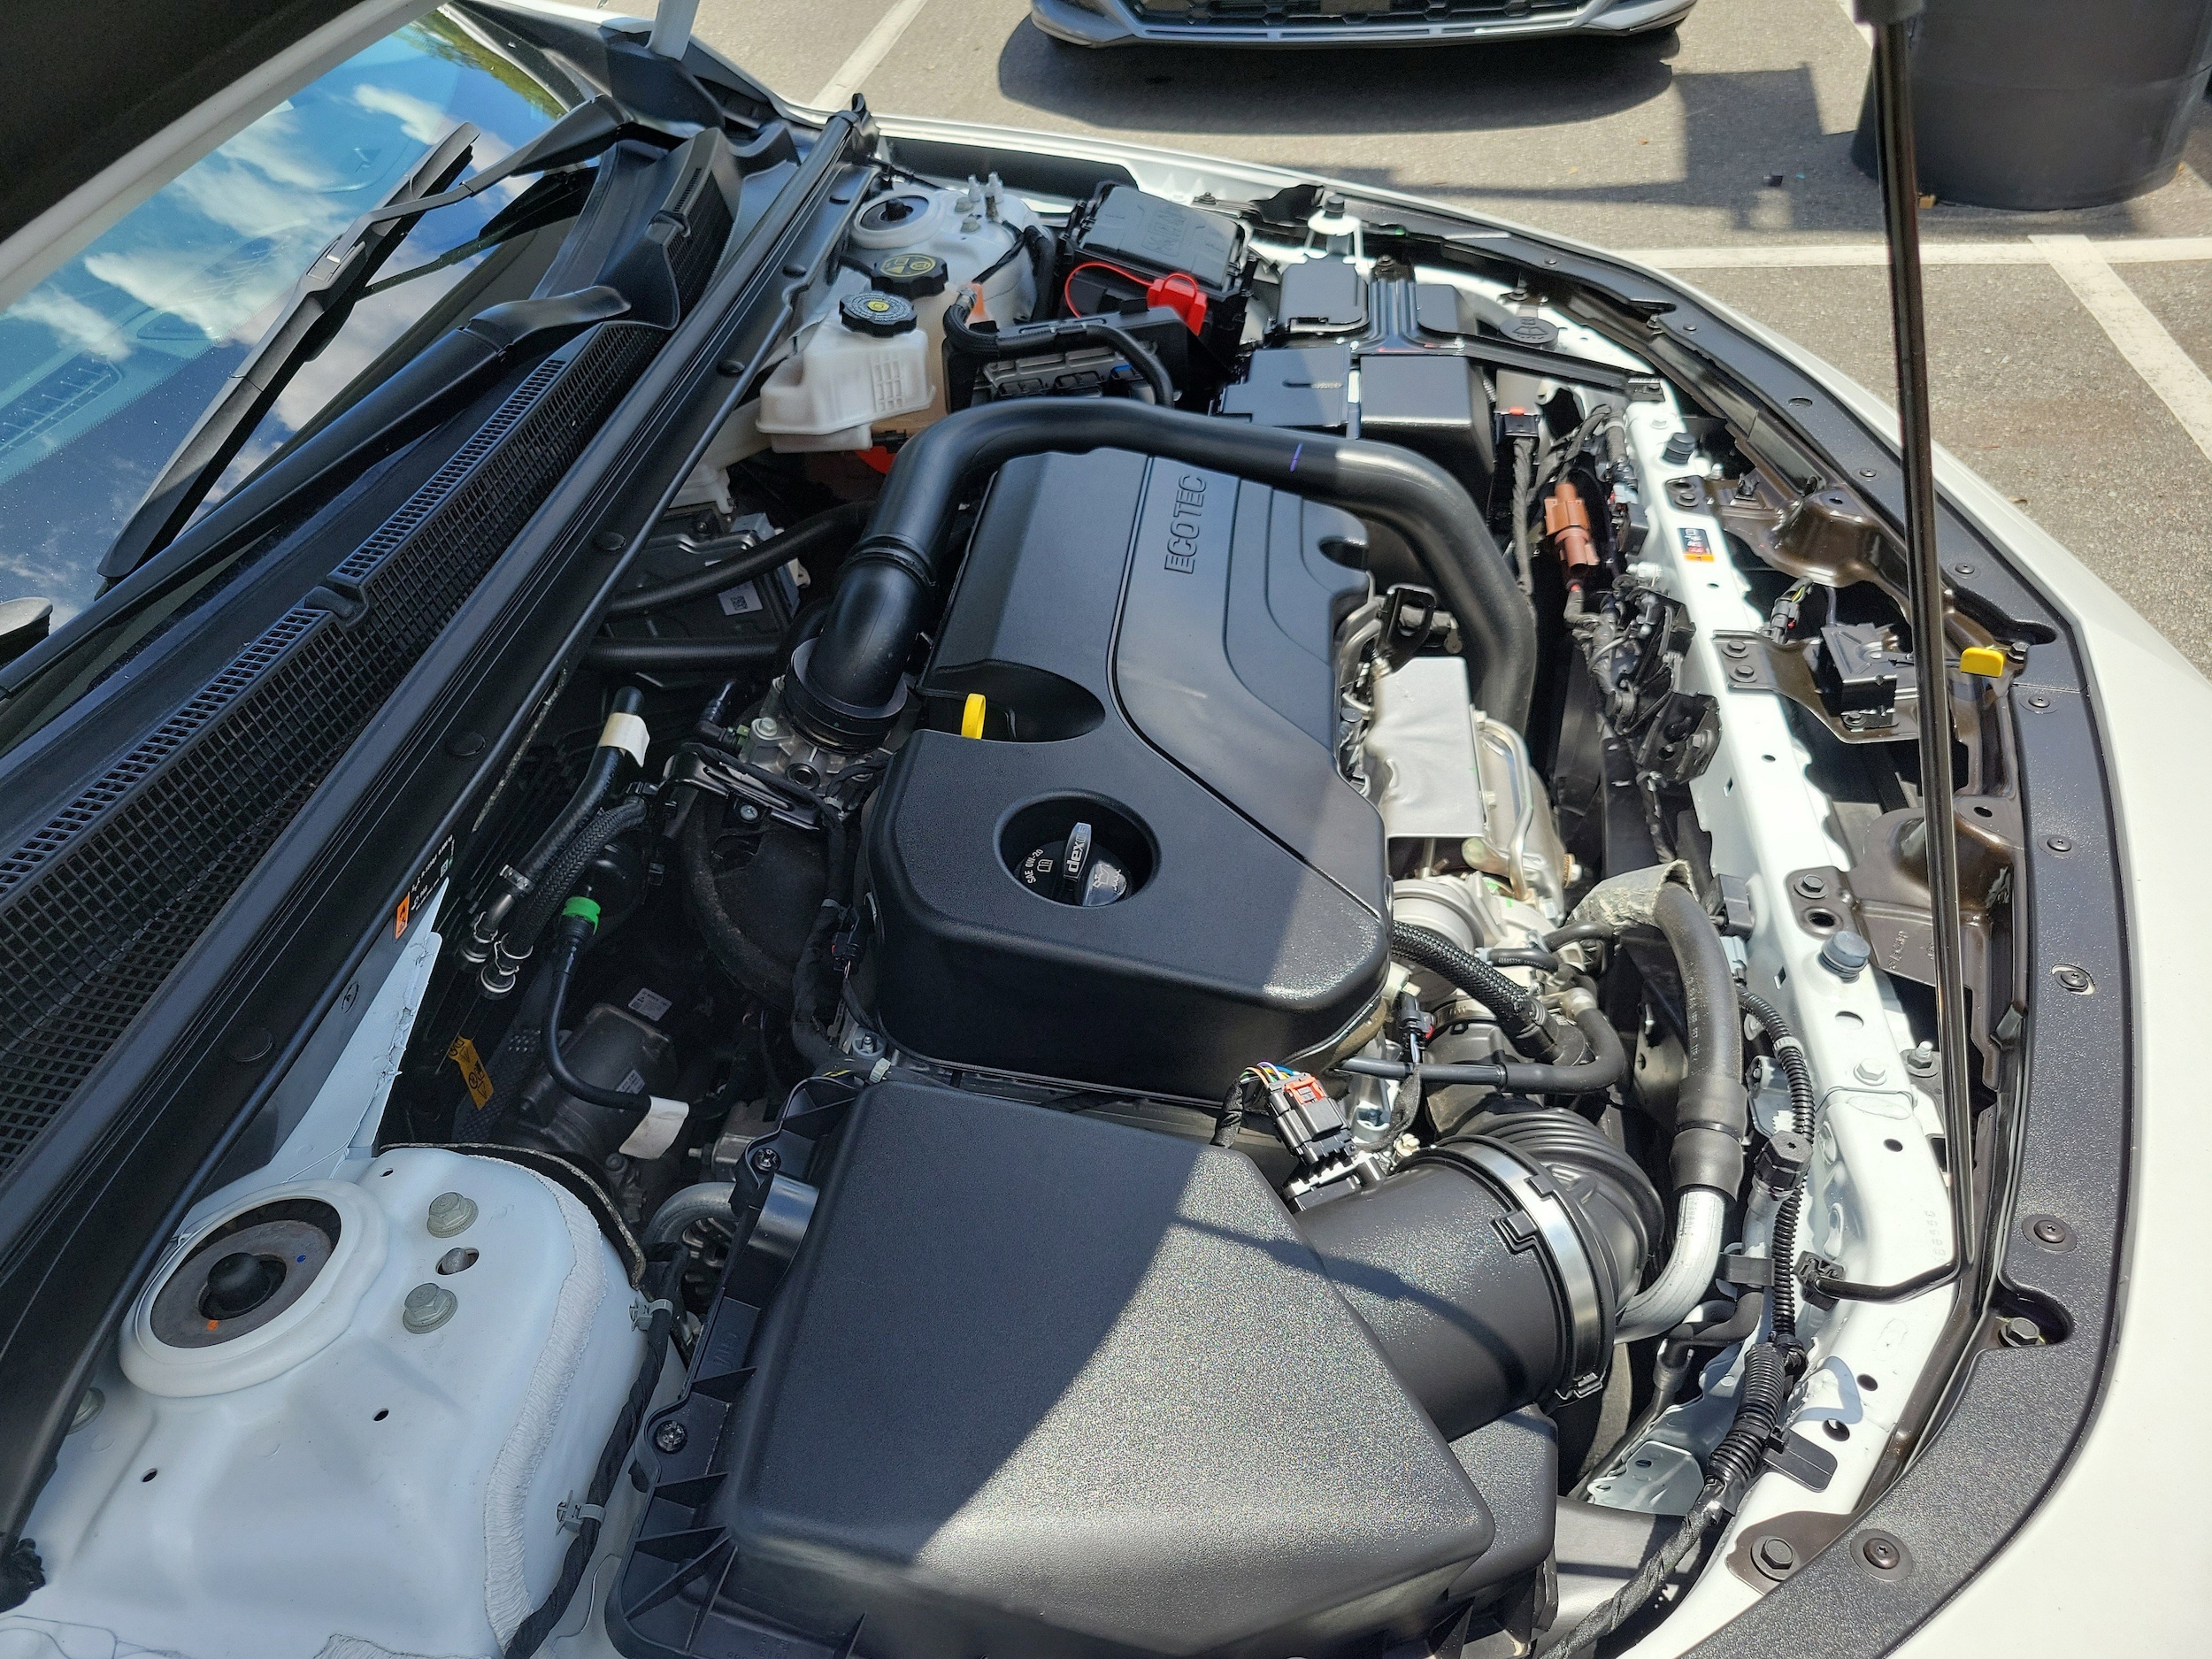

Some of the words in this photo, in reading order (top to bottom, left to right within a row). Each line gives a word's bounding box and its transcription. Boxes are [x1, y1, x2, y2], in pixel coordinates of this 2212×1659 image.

[1164, 475, 1206, 574] ECOTEC
[1066, 826, 1089, 872] dexos
[1024, 870, 1036, 884] SAE
